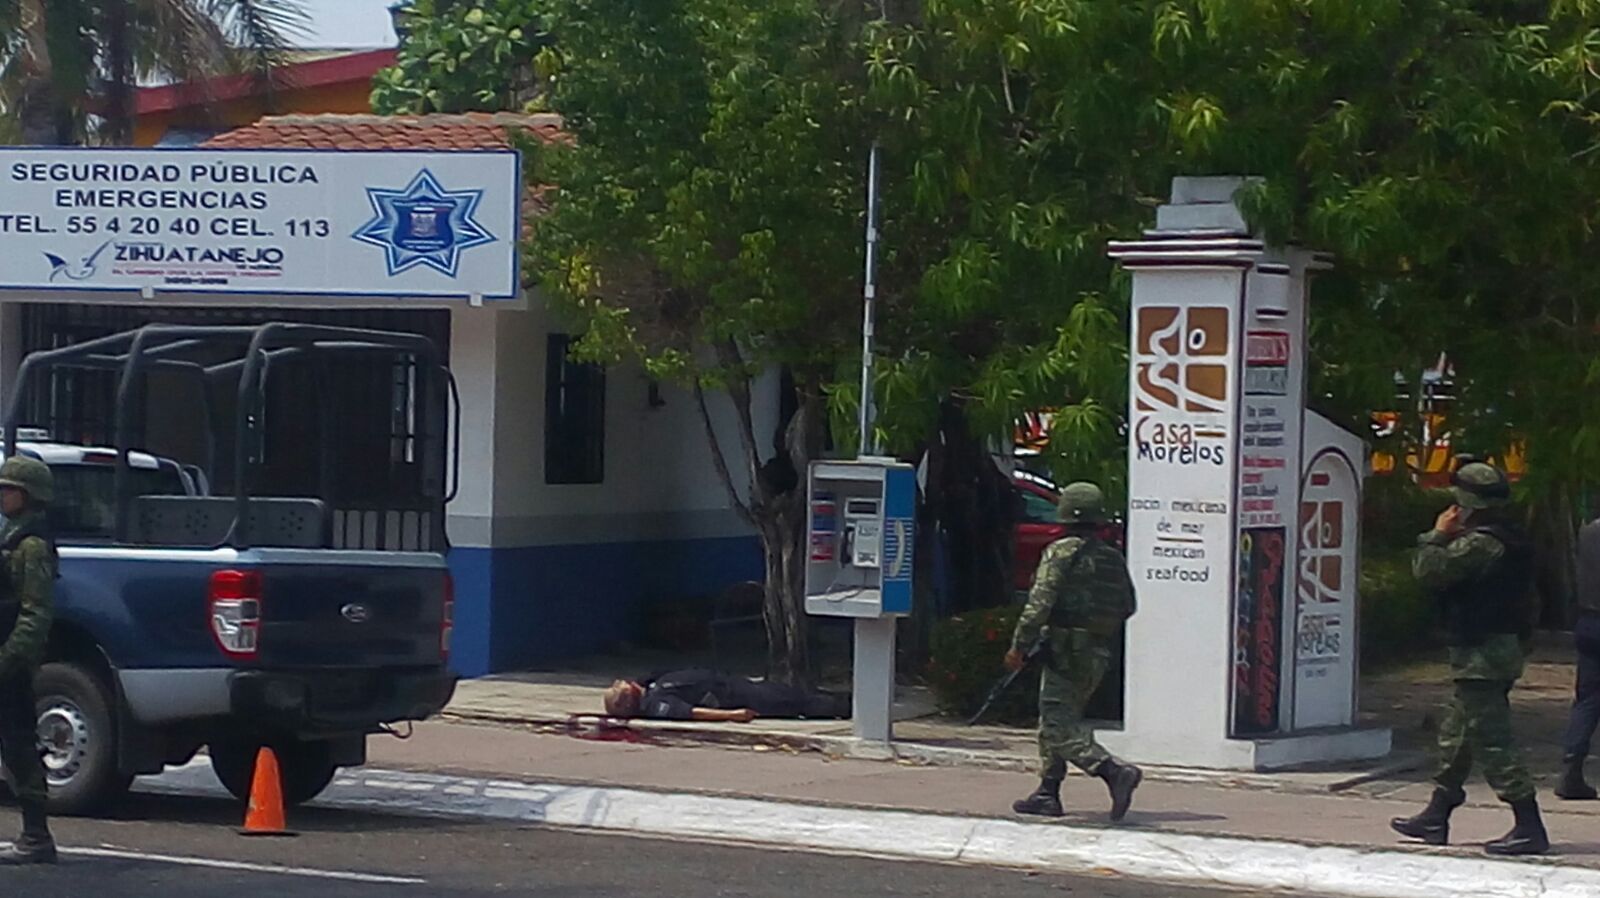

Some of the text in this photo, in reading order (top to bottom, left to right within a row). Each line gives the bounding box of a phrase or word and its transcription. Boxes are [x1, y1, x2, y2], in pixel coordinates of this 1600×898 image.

[12, 160, 319, 184] SEGURIDAD PÚBLICA
[56, 189, 267, 209] EMERGENCIAS
[0, 215, 329, 237] TEL. 55 4 20 40 CEL. 113
[115, 246, 283, 264] ZIHUATANEJO
[1135, 416, 1192, 447] Casa
[1137, 440, 1225, 466] Morelos
[1156, 516, 1173, 532] de
[1152, 545, 1205, 559] mexican
[1146, 565, 1210, 583] seafood
